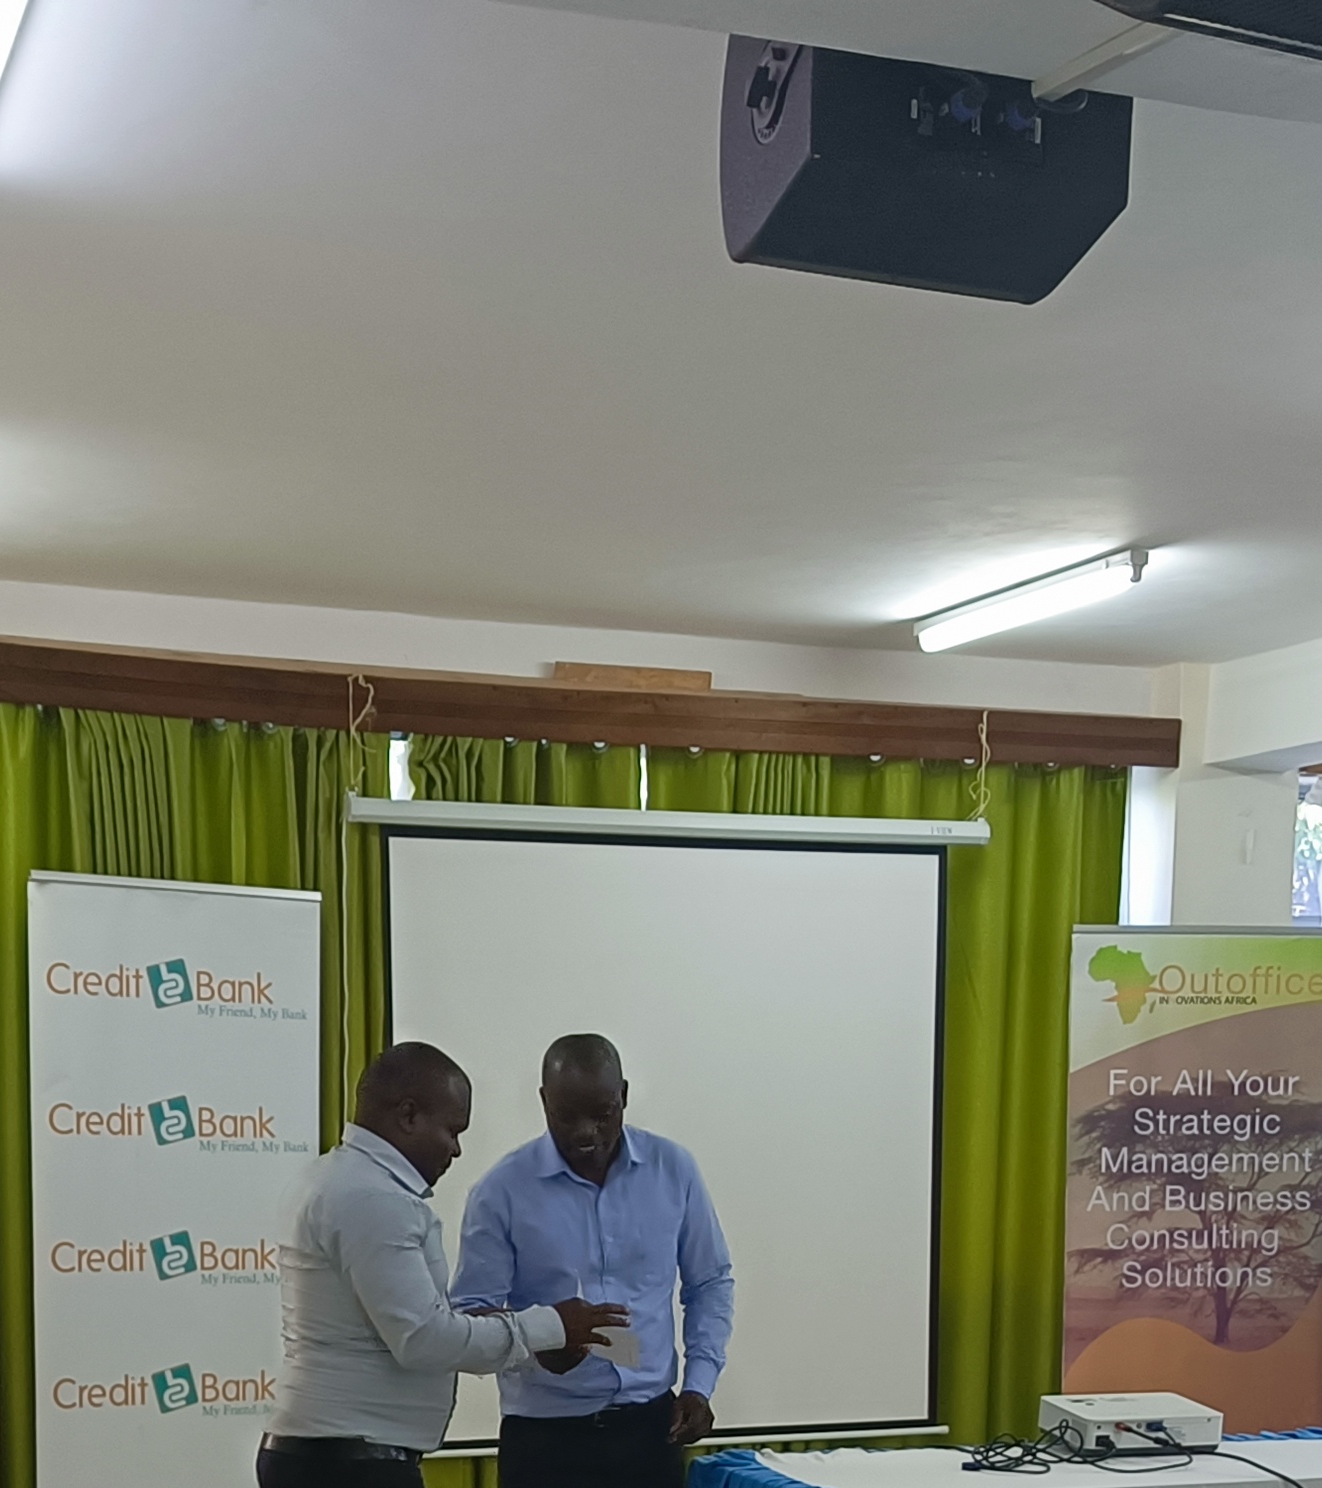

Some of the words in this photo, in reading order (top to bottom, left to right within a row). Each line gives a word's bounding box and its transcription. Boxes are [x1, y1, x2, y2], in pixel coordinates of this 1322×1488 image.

[46, 962, 144, 998] Credit
[196, 970, 274, 1005] Bank
[197, 1004, 216, 1019] My
[260, 1007, 278, 1021] My
[282, 1008, 308, 1021] Bank
[1224, 995, 1258, 1006] AFRICA
[1108, 1068, 1162, 1097] For
[1172, 1068, 1212, 1097] All
[1226, 1068, 1300, 1097] Your
[48, 1102, 146, 1137] Credit
[198, 1105, 276, 1140] Bank
[1133, 1107, 1281, 1142] Strategic
[199, 1140, 218, 1154] My
[262, 1141, 280, 1155] My
[283, 1141, 309, 1153] Bank
[1100, 1146, 1313, 1180] Management
[1086, 1185, 1150, 1212] And
[1165, 1184, 1311, 1212] Business
[1106, 1223, 1279, 1256] Consulting
[50, 1239, 147, 1273] Credit
[200, 1238, 277, 1271] Bank
[201, 1273, 220, 1287] My
[1121, 1261, 1273, 1288] Solutions
[52, 1373, 149, 1410] Credit
[201, 1369, 277, 1403] Bank
